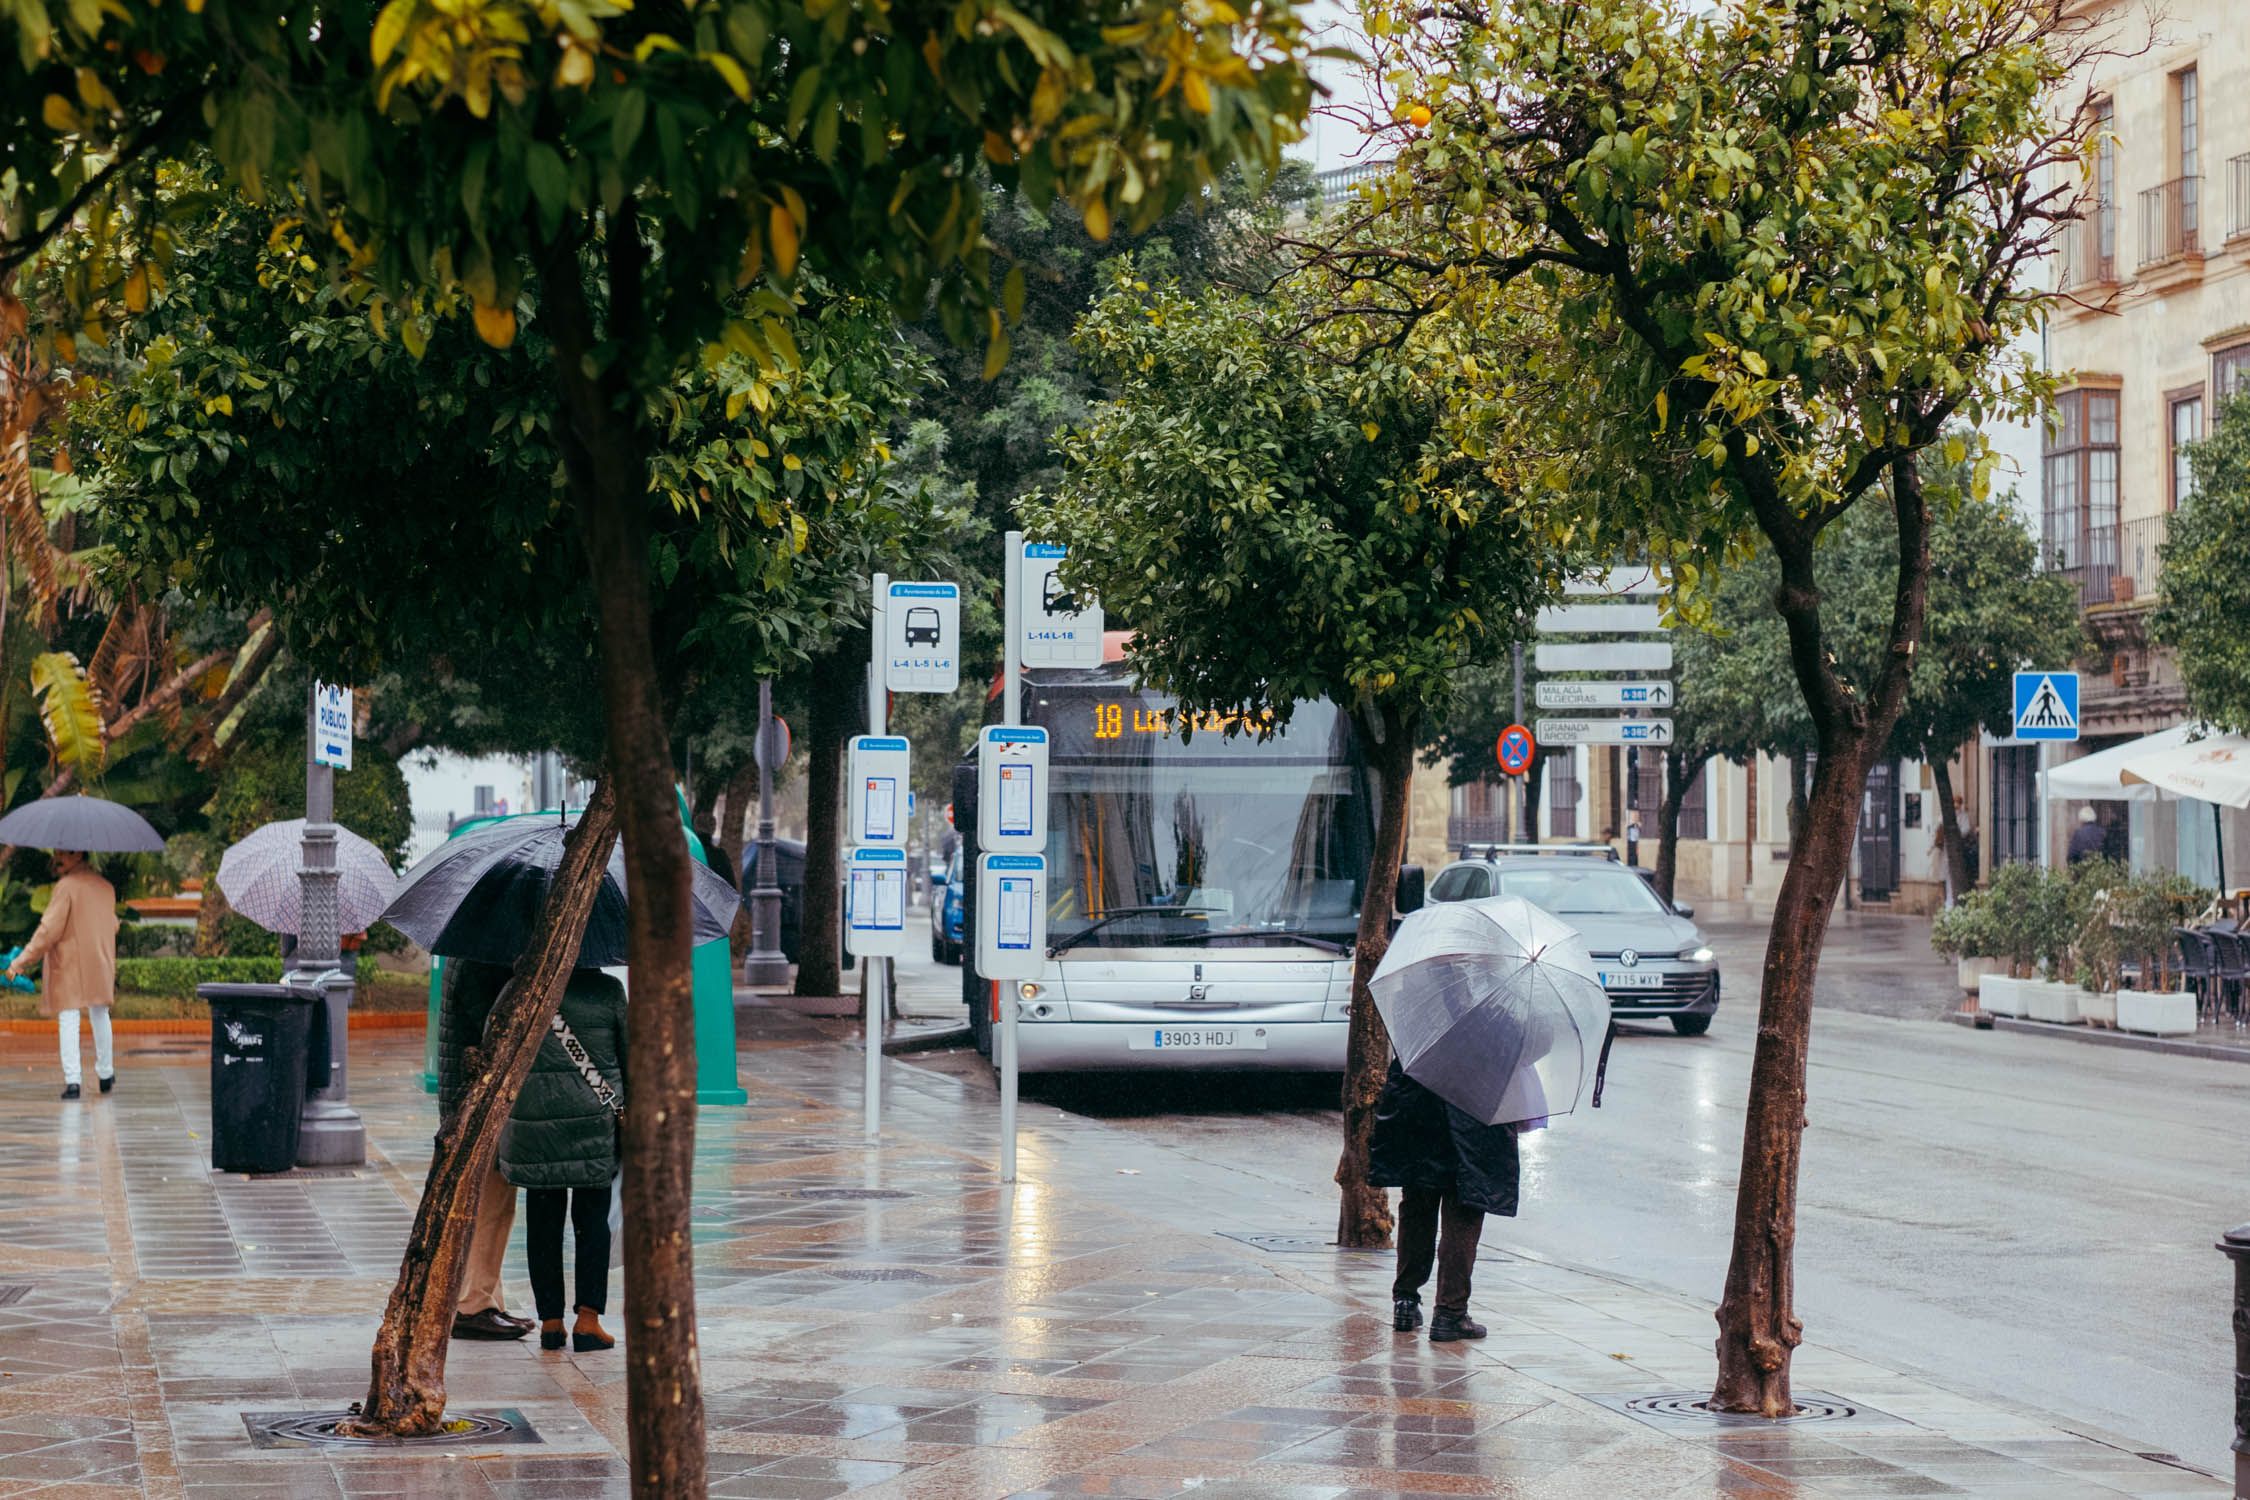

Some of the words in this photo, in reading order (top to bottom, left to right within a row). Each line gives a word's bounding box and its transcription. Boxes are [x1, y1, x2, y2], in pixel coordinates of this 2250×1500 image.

[1028, 632, 1050, 640] L-14
[1052, 632, 1074, 640] L-18
[894, 660, 909, 668] L-4
[914, 660, 930, 668] L-5
[934, 660, 950, 668] L-6
[1542, 695, 1597, 704] ALGECIRAS
[1094, 704, 1123, 738] 18
[1543, 724, 1590, 732] GRANADA
[1543, 732, 1578, 740] ARCOS
[1608, 975, 1636, 984] 7115
[1640, 975, 1660, 984] MXY
[1163, 1032, 1201, 1046] 3903
[1206, 1032, 1234, 1046] HDJ
